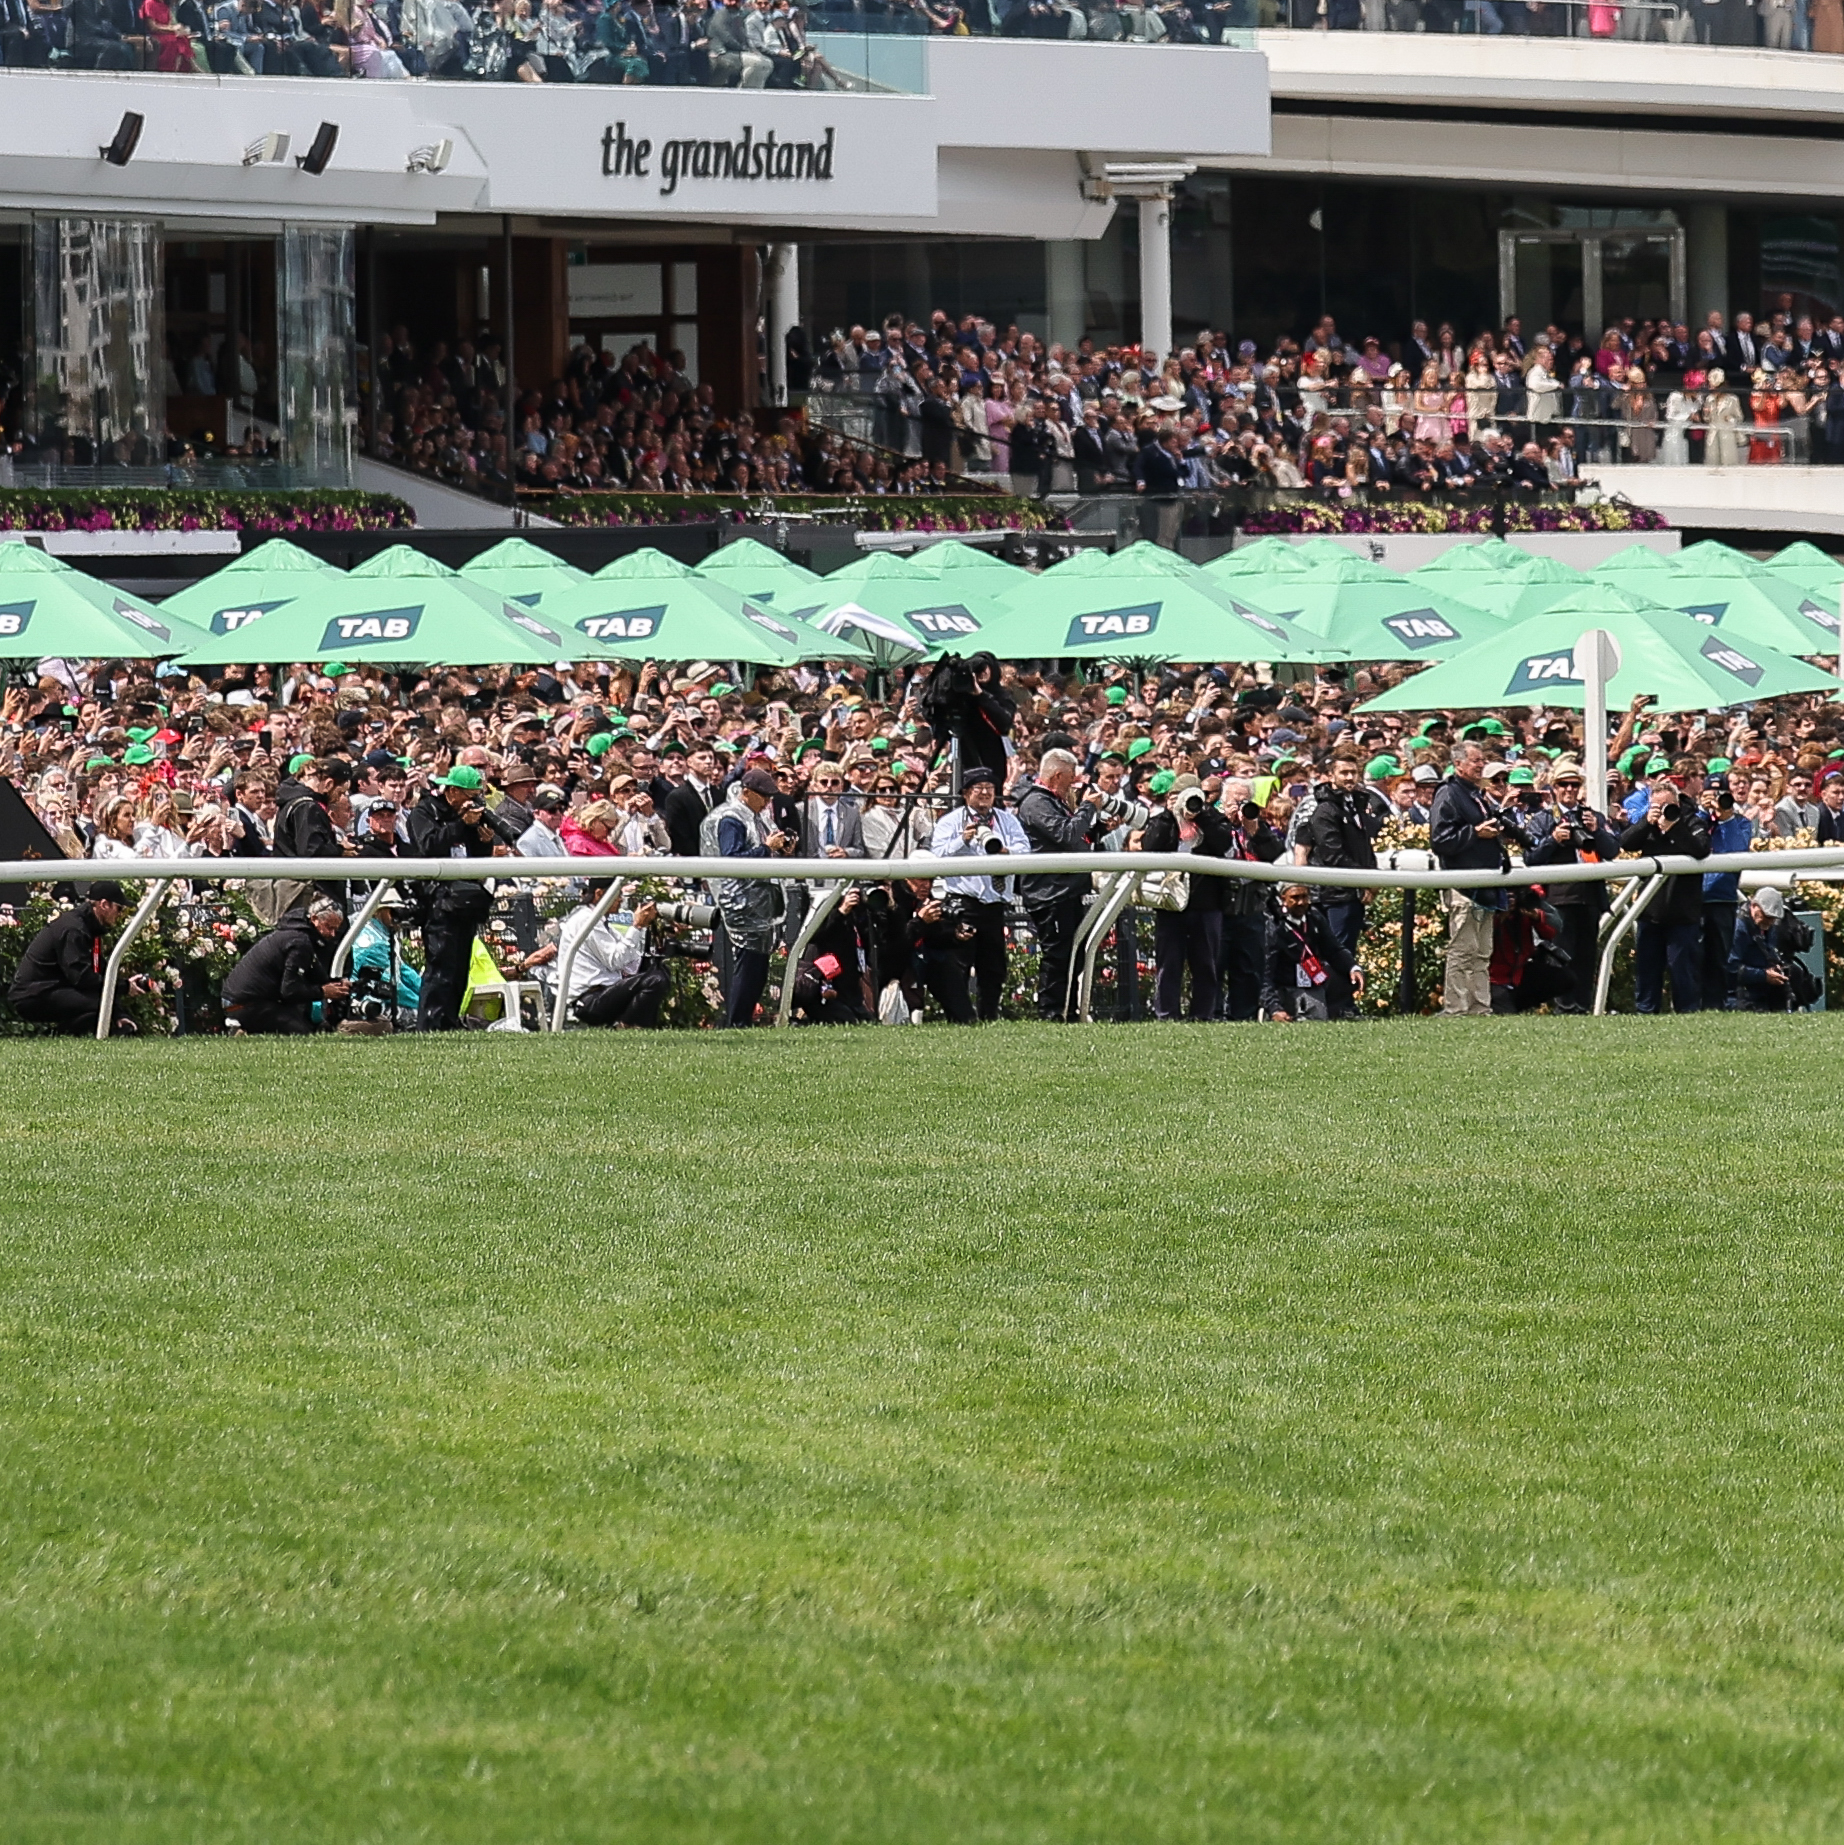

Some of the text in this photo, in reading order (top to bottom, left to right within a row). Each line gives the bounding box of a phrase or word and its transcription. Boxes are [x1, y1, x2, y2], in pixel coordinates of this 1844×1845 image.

[600, 121, 835, 196] the grandstand
[222, 610, 263, 630] TA
[337, 618, 410, 638] TAB
[584, 617, 653, 638] TAB
[911, 613, 980, 633] TAB
[1080, 615, 1150, 634] TAB
[1388, 618, 1454, 638] TAB
[1527, 656, 1585, 681] TA
